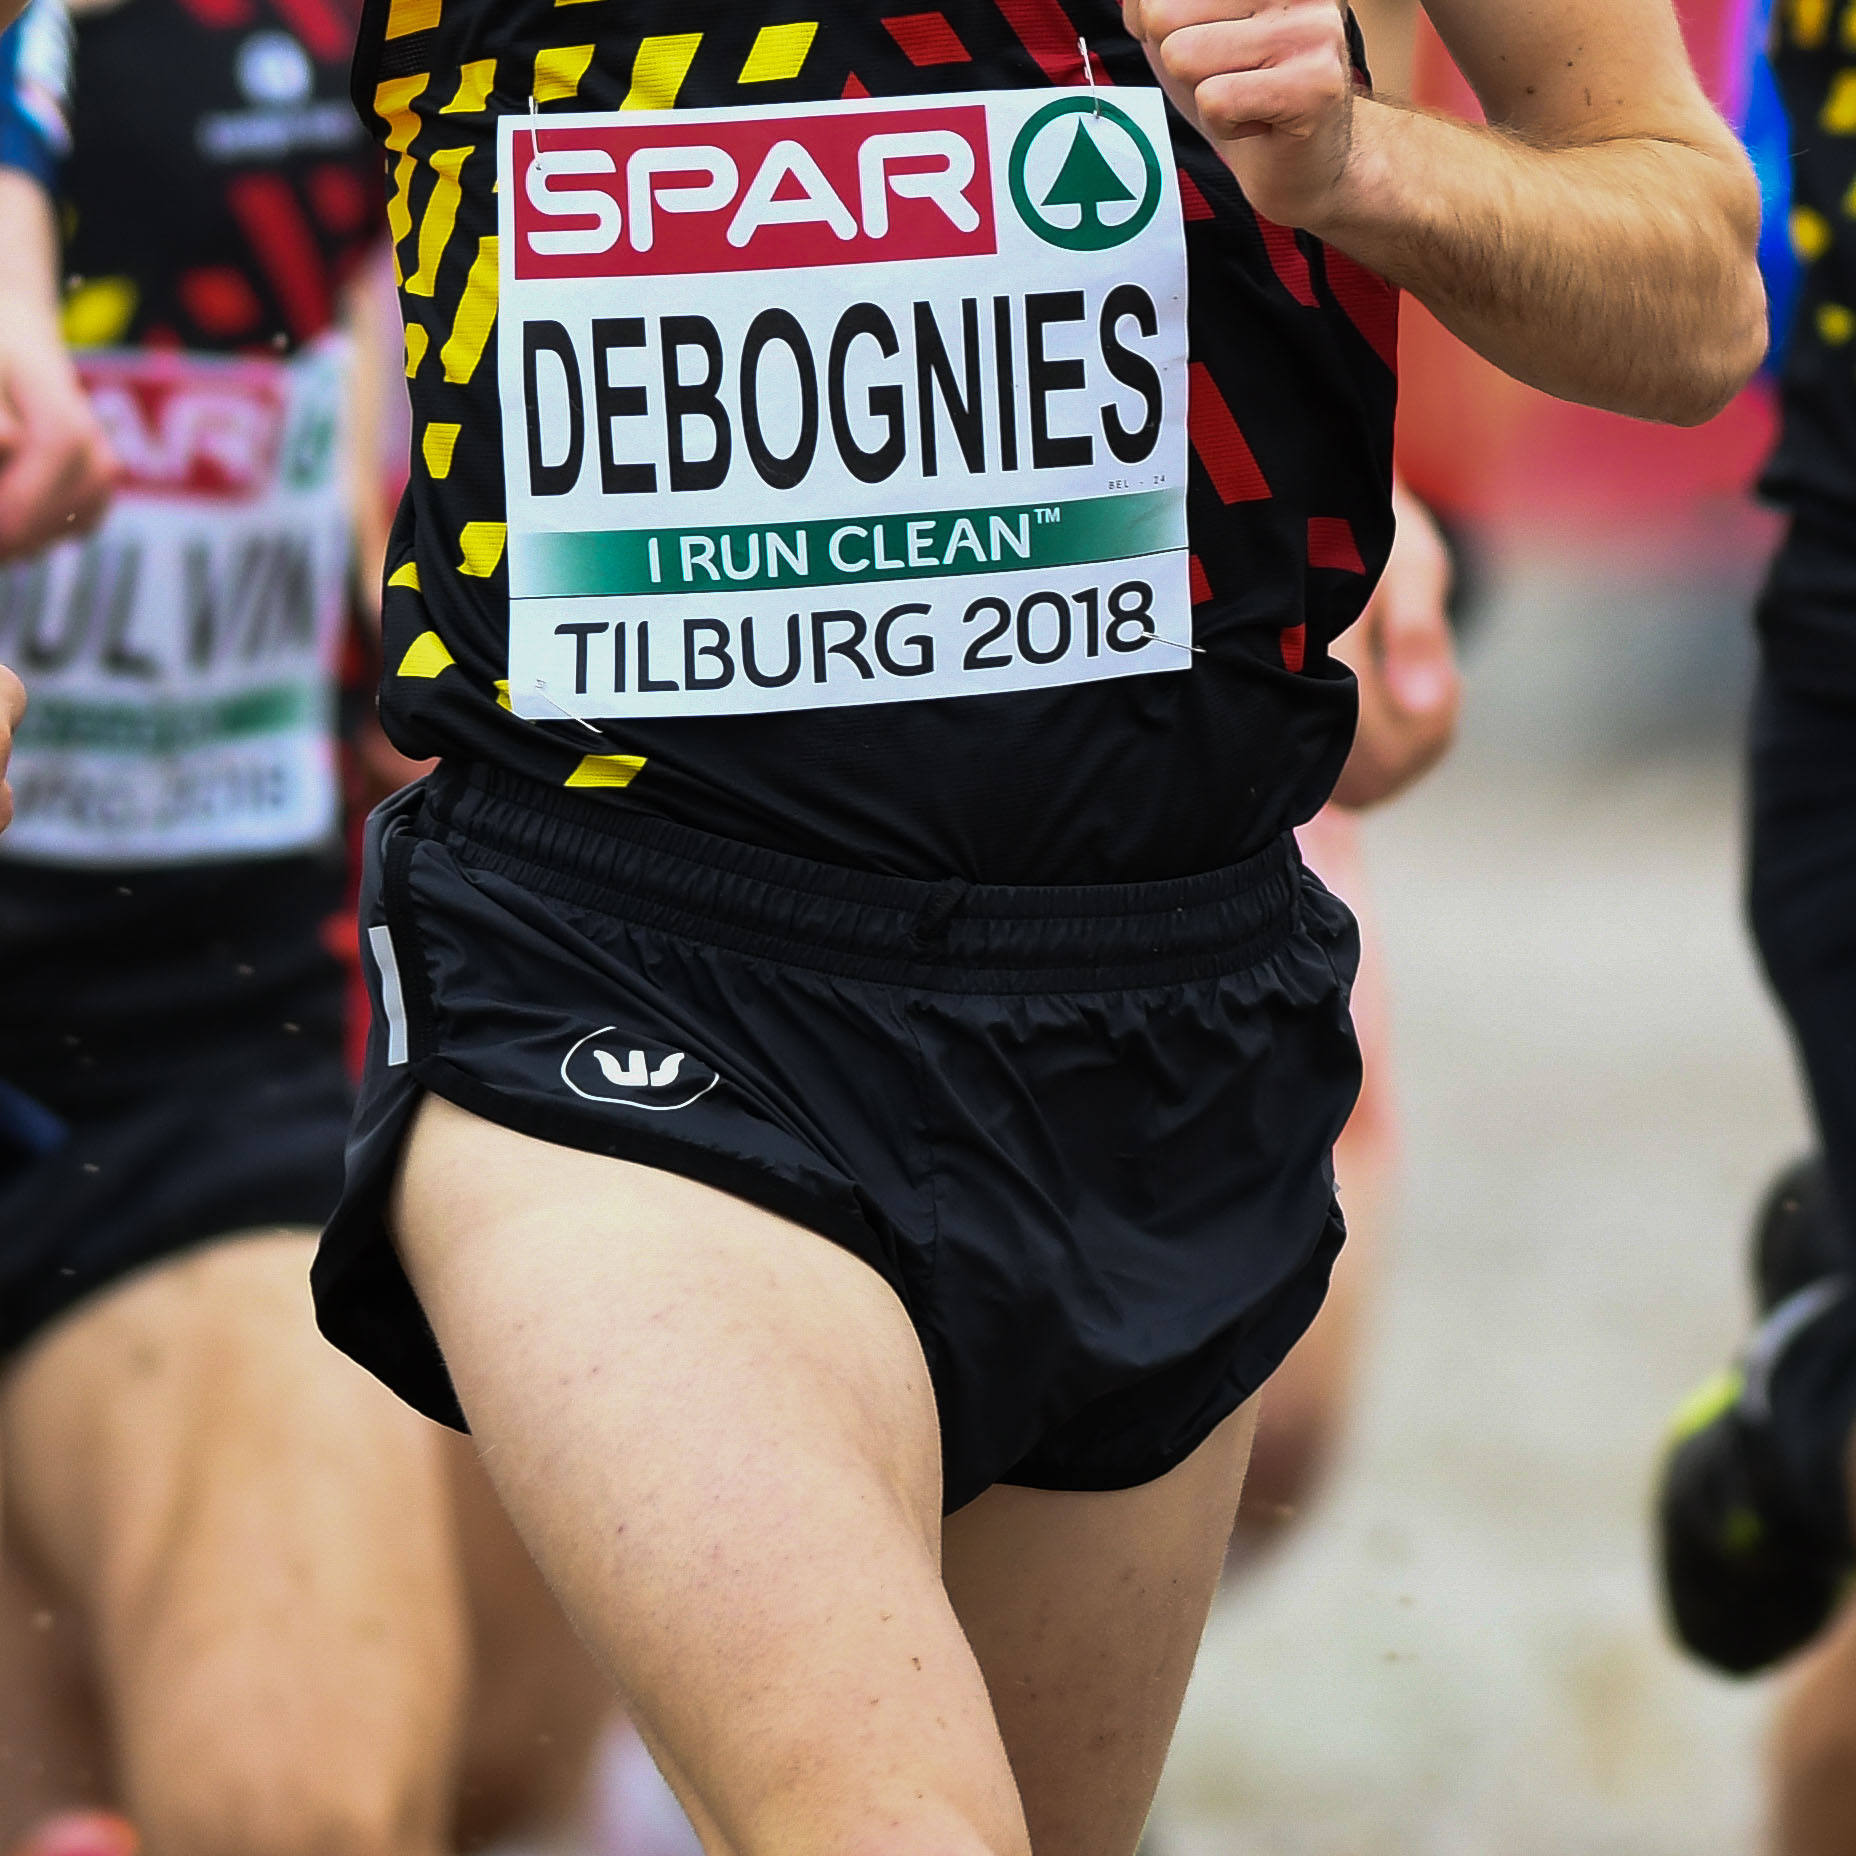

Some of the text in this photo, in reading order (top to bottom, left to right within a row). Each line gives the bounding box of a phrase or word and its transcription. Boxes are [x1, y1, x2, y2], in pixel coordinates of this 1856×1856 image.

[527, 128, 981, 254] SPAR
[522, 282, 1161, 497] DEBOGNIES
[649, 537, 661, 584] I
[680, 528, 808, 582] RUN
[555, 579, 1156, 695] TILBURG 2018
